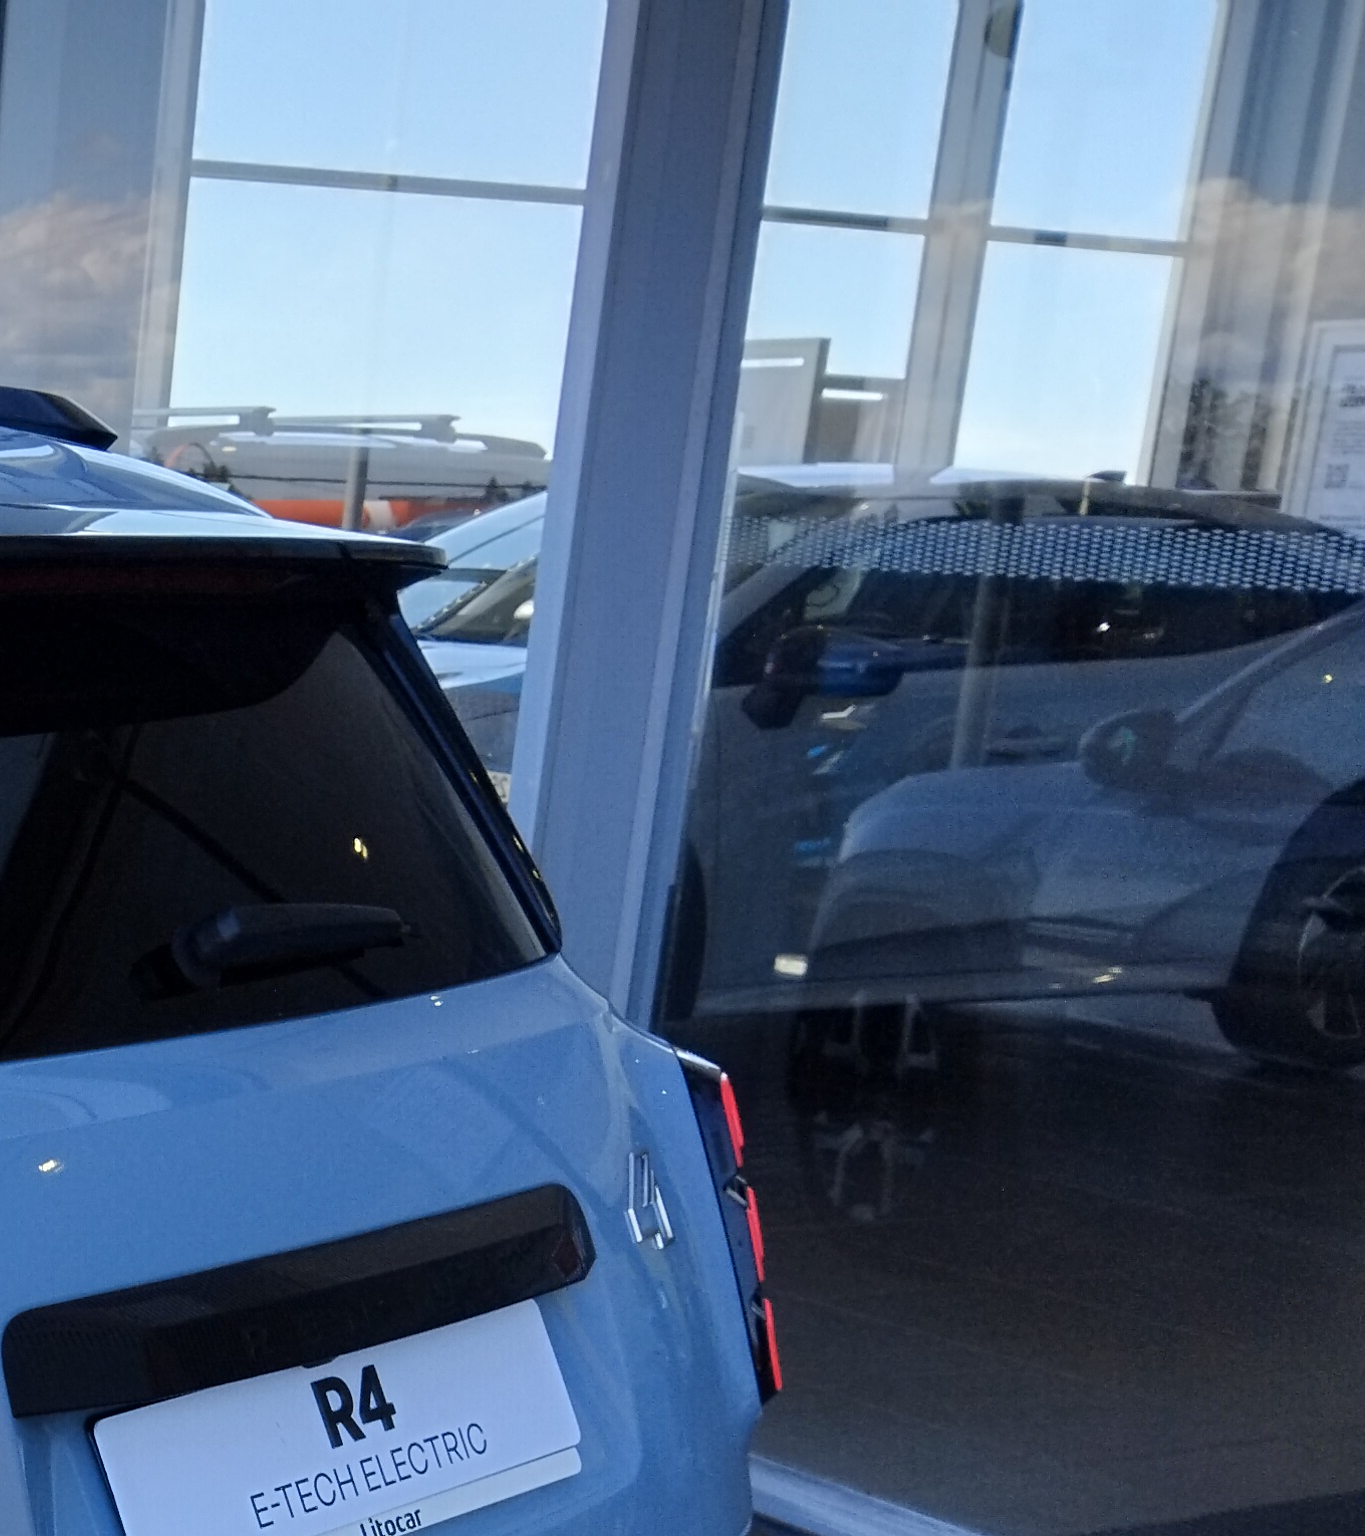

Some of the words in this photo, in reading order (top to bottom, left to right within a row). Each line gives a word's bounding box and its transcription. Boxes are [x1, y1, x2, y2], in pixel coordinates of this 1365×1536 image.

[310, 1364, 396, 1449] R4
[250, 1463, 359, 1529] E-TECH
[359, 1422, 488, 1492] ELECTRIC
